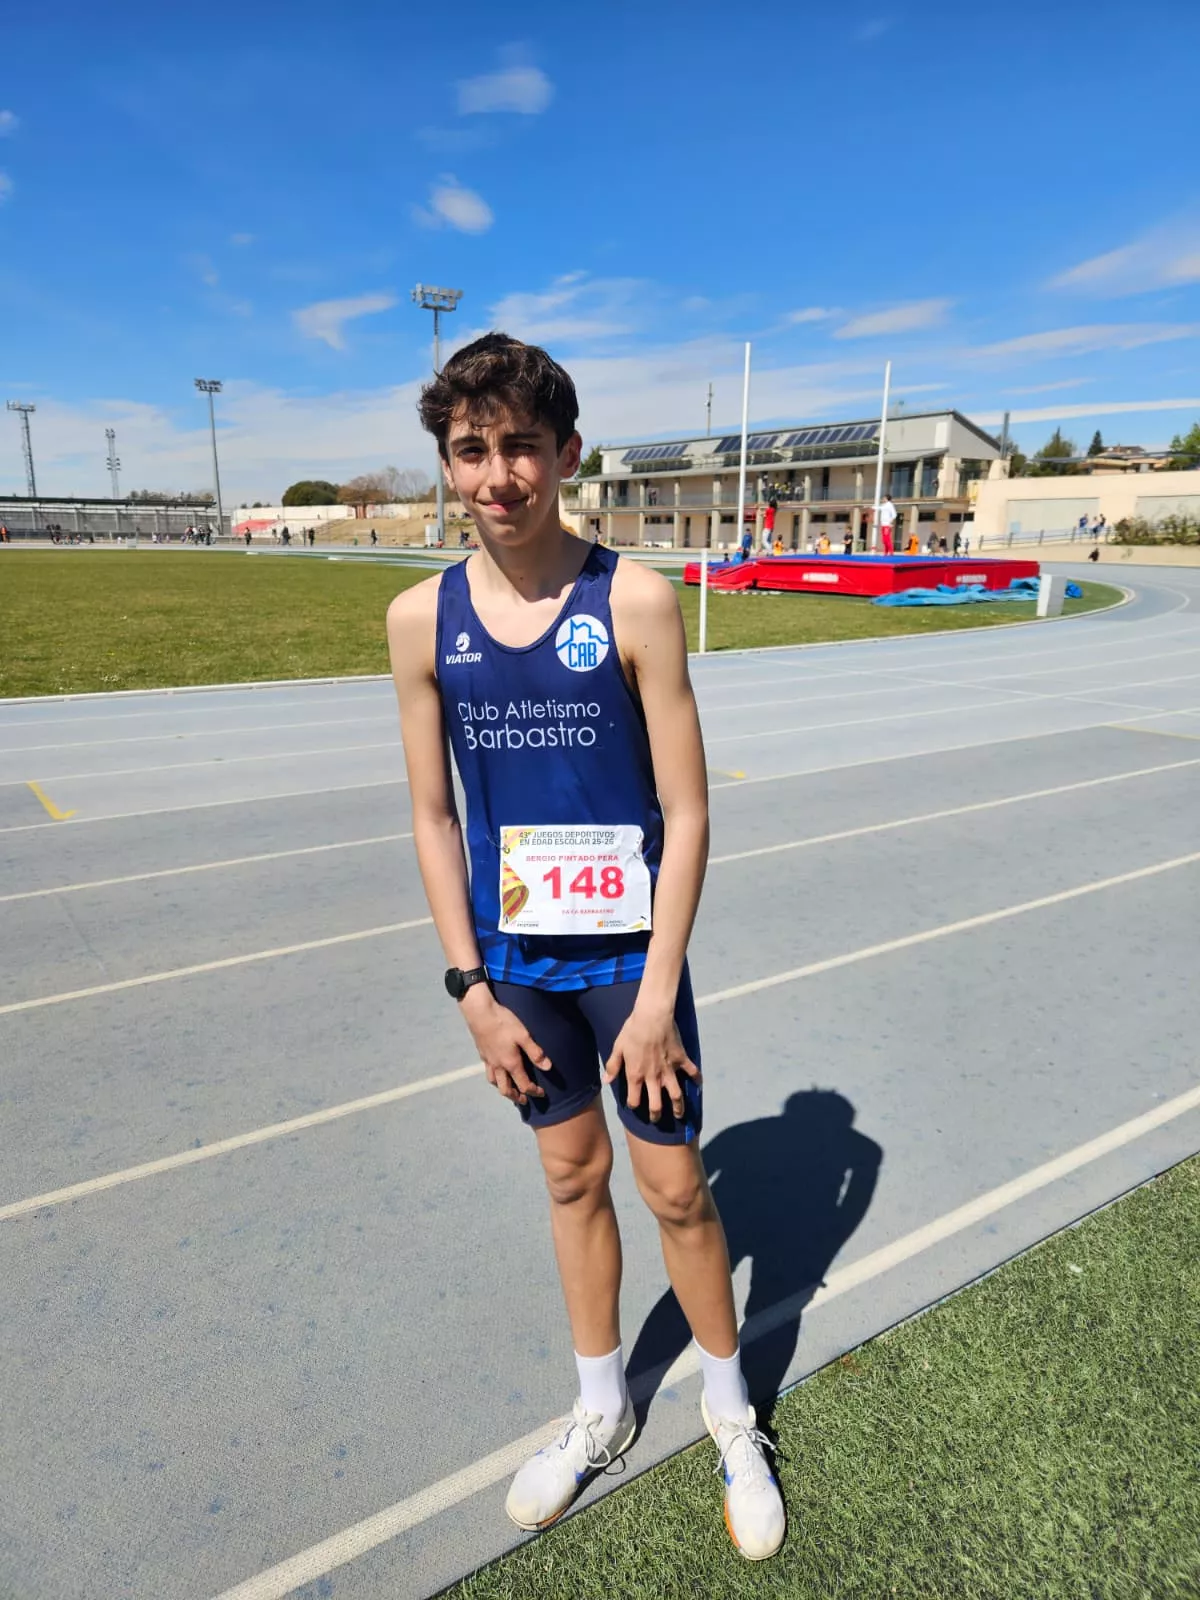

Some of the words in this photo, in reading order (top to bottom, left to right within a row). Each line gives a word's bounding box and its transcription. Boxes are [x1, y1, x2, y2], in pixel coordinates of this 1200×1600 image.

[445, 652, 482, 665] VIATOR
[568, 642, 598, 668] CAB
[457, 702, 499, 722] Club
[505, 699, 601, 720] Atletismo
[464, 722, 596, 750] Barbastro
[534, 831, 564, 839] JUEGOS
[565, 831, 615, 839] DEPORTIVOS
[543, 866, 625, 899] 148
